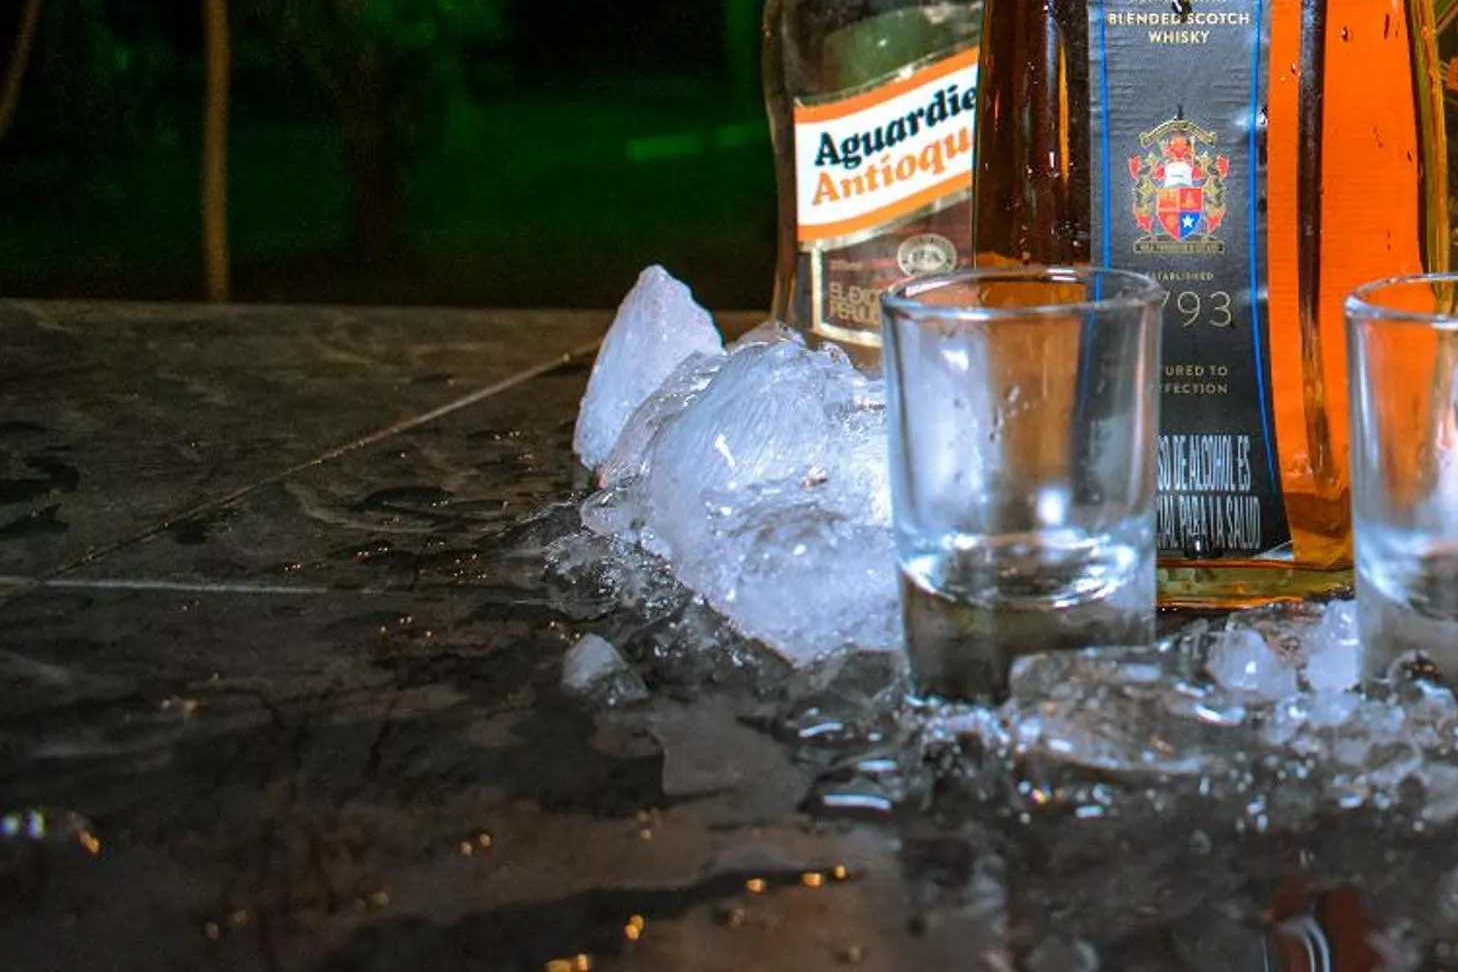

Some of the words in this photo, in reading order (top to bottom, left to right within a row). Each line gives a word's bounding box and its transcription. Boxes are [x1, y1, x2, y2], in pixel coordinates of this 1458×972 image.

[1107, 12, 1182, 26] BLENDED
[1186, 12, 1251, 26] SCOTCH
[1148, 29, 1211, 45] WHISKY
[814, 84, 978, 170] Aguardie
[811, 126, 971, 207] Antioqu
[1164, 364, 1205, 377] URED
[1163, 382, 1229, 396] FECTION
